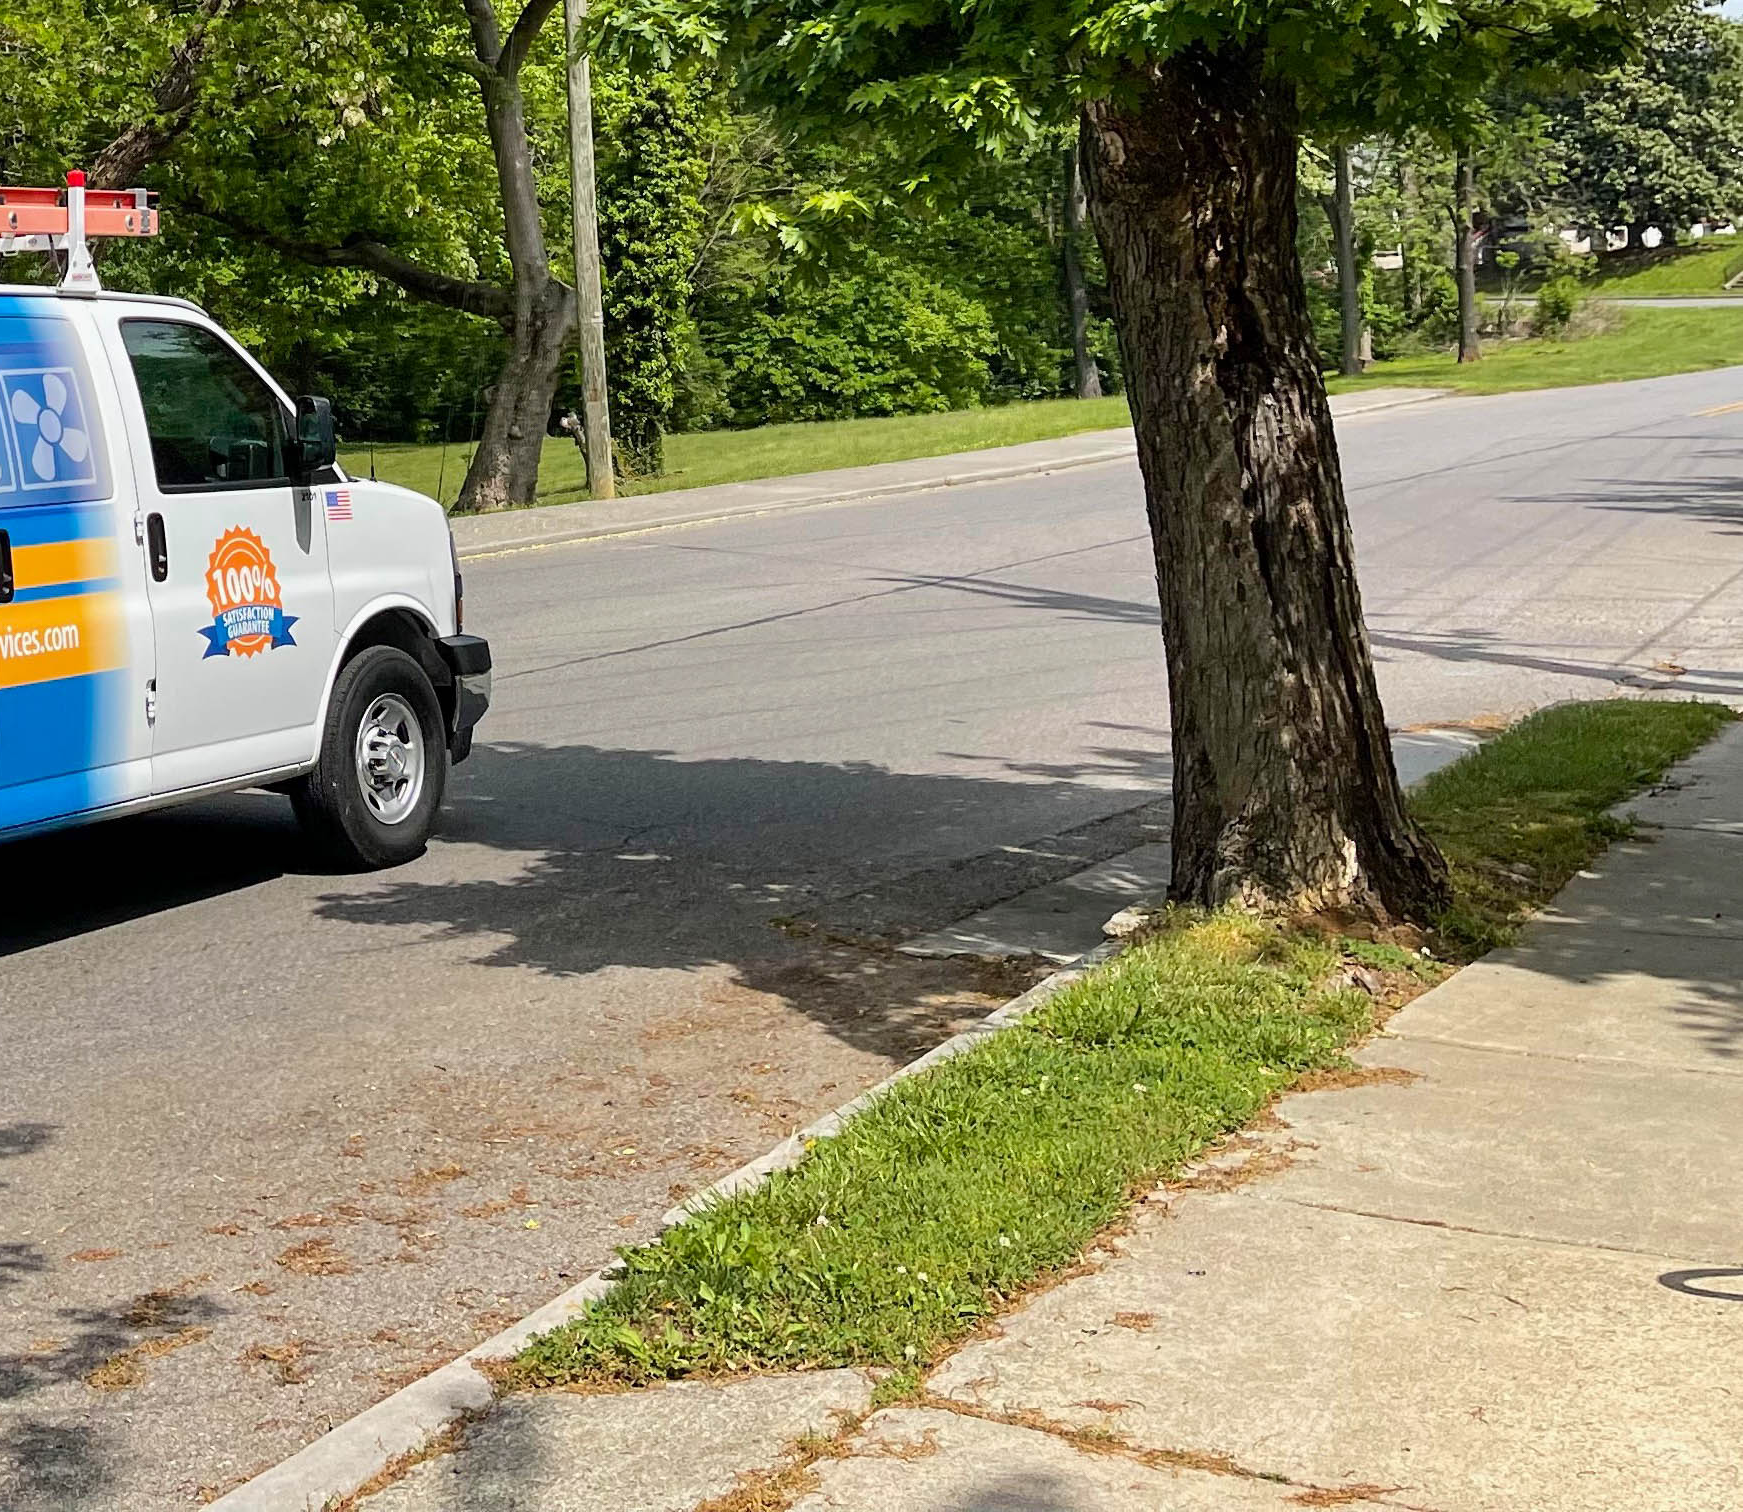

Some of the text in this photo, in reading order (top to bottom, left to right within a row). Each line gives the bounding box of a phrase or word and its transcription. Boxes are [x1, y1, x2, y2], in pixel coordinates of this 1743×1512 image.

[212, 564, 275, 606] 100%
[222, 606, 275, 628] SATISFACTION
[227, 620, 270, 639] GUARANTEE
